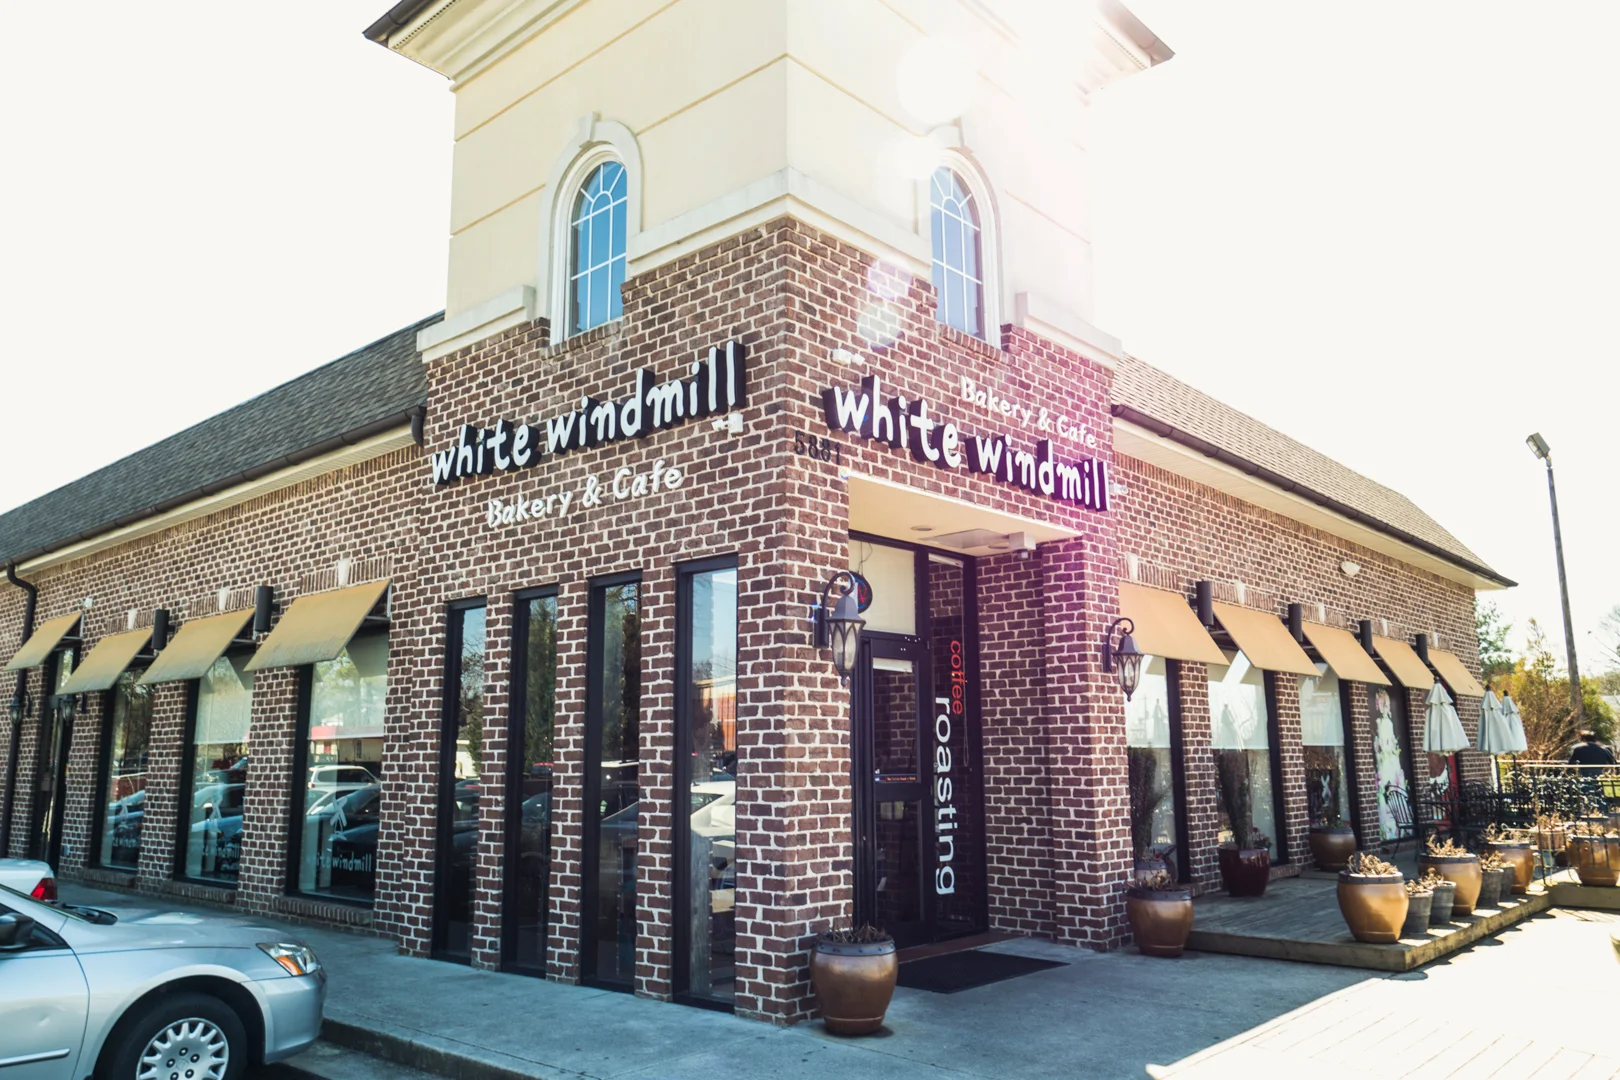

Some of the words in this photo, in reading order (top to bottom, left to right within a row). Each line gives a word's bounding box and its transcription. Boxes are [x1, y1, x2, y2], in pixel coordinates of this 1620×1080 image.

[431, 418, 537, 485] white
[547, 340, 742, 454] windmill
[794, 430, 841, 466] 5881
[829, 375, 961, 468] white
[971, 434, 1111, 512] windmill
[959, 375, 1032, 428] Bakery
[1036, 406, 1052, 433] &
[1056, 414, 1098, 449] Cafe
[487, 489, 574, 528] Bakery
[584, 474, 603, 508] &
[612, 459, 685, 498] Cafe
[949, 639, 967, 716] coffee
[935, 696, 958, 896] roasting
